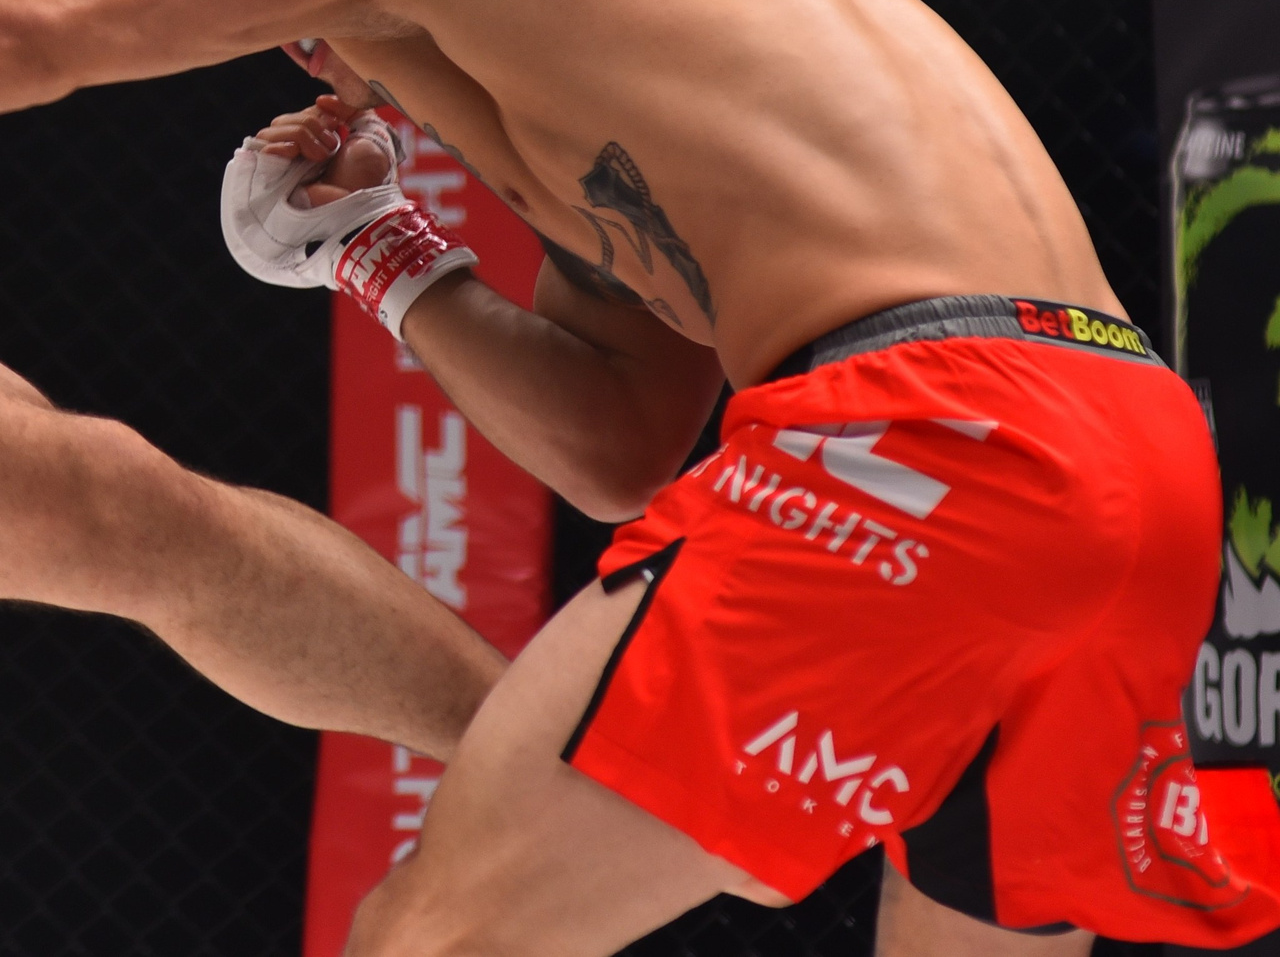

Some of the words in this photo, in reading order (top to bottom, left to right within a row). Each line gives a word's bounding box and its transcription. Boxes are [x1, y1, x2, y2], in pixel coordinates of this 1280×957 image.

[1015, 300, 1148, 355] BetBoom
[713, 454, 930, 586] NIGHTS
[743, 710, 910, 825] AMC
